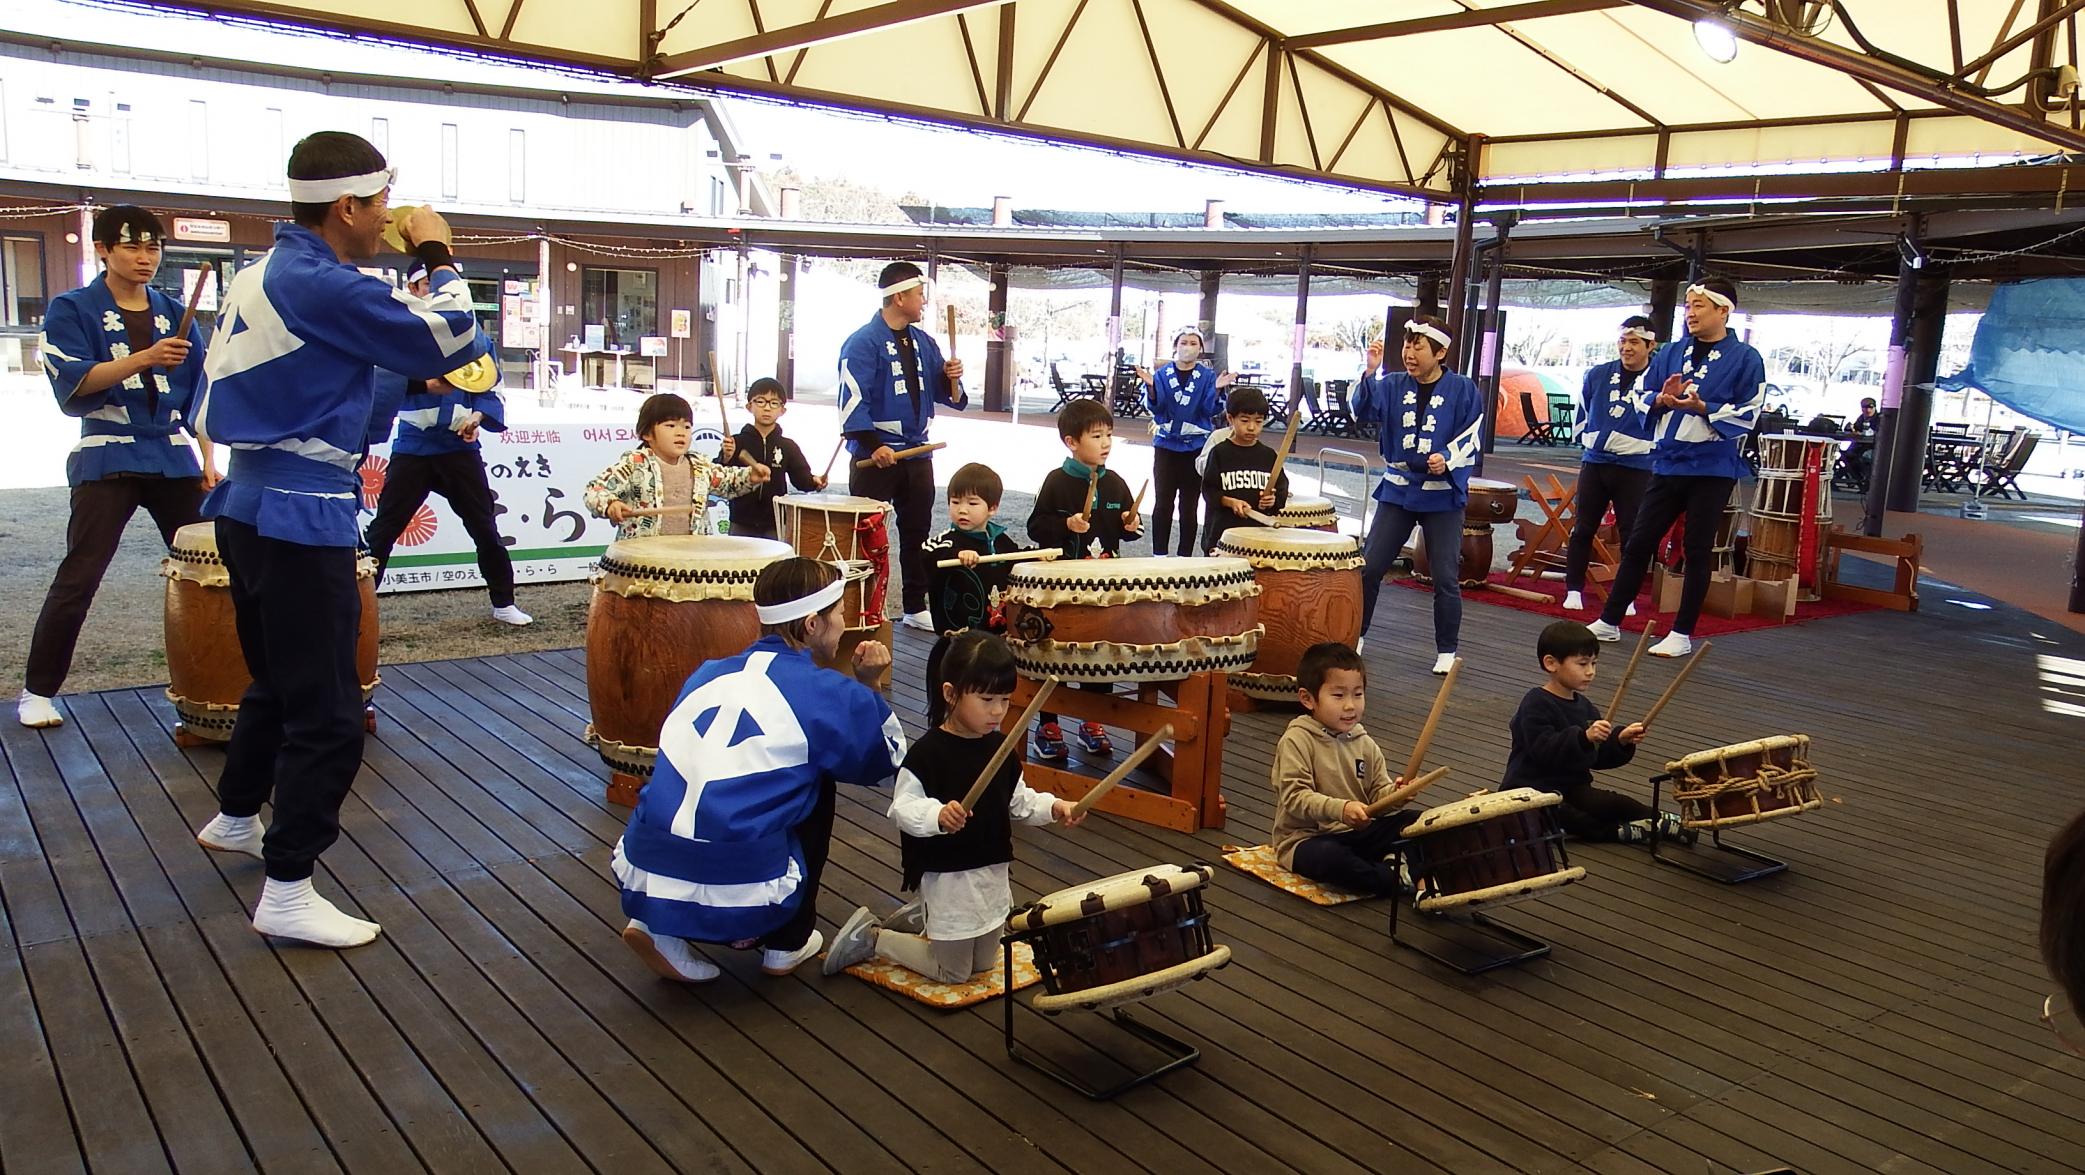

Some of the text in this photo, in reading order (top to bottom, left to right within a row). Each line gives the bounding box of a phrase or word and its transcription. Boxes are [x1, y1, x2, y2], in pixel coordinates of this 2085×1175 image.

[500, 430, 560, 444] 欢迎光临
[583, 428, 612, 442] 어서
[483, 453, 552, 478] のえき
[383, 572, 432, 585] 小美玉市
